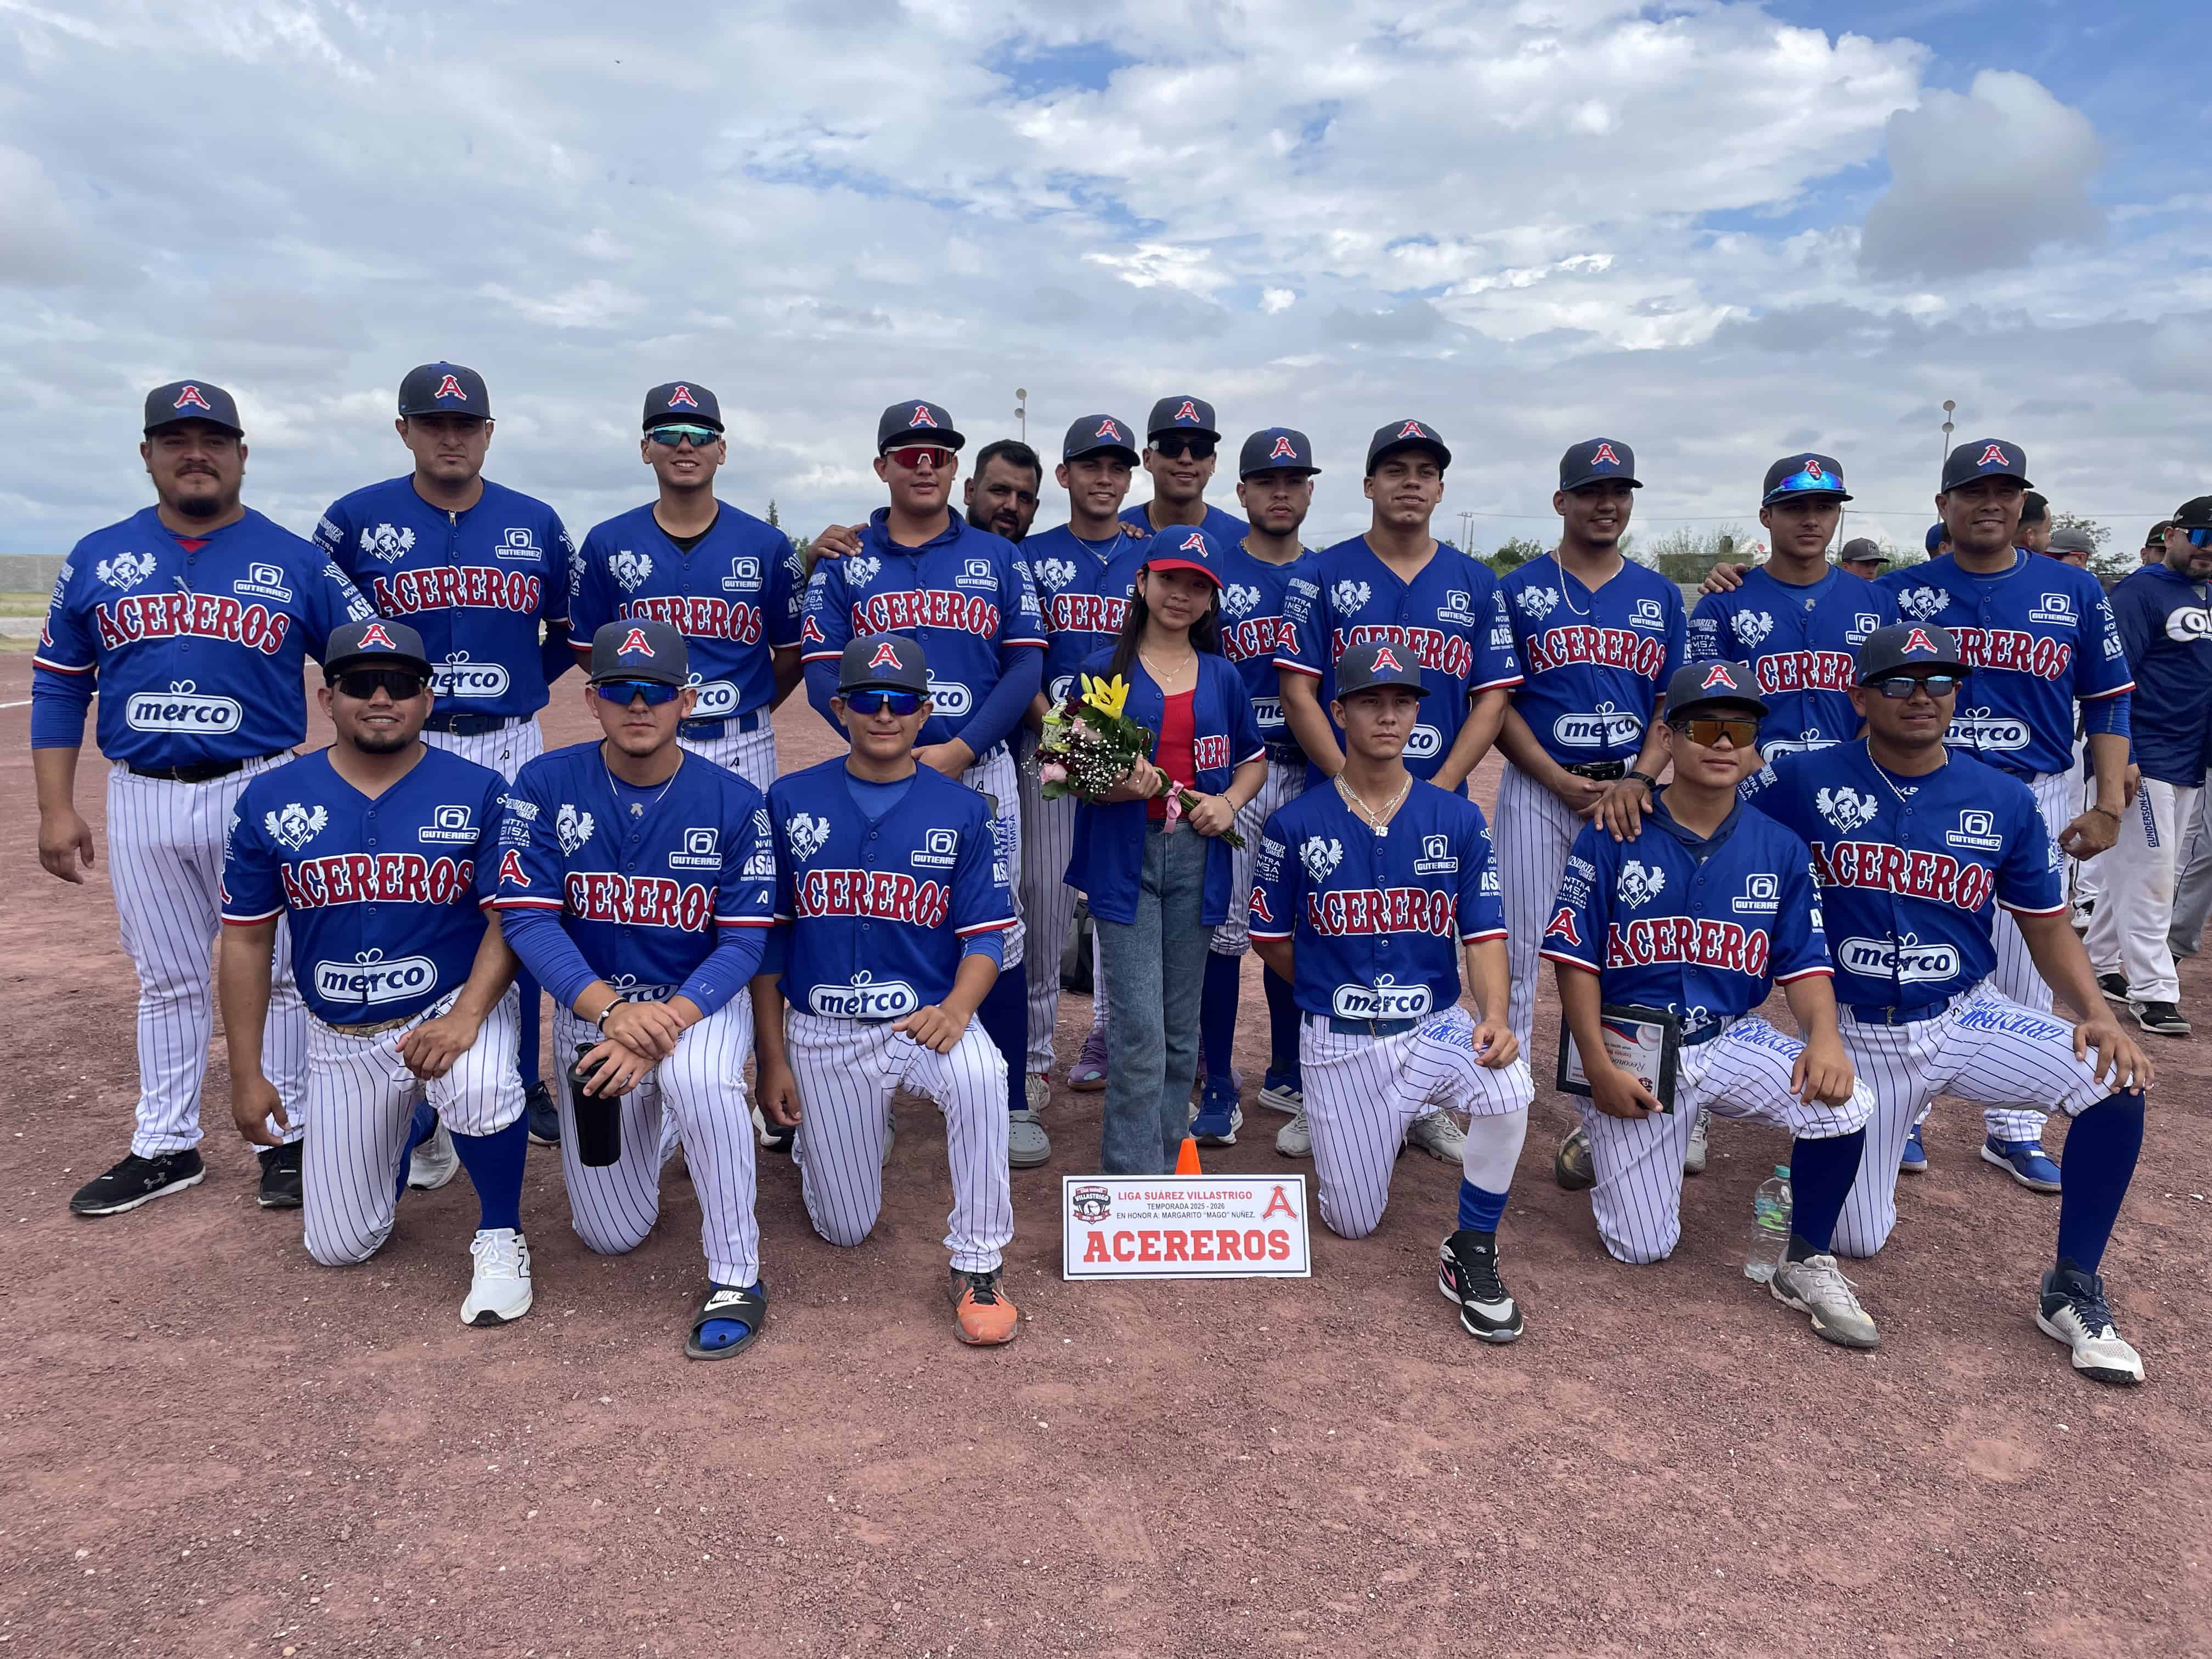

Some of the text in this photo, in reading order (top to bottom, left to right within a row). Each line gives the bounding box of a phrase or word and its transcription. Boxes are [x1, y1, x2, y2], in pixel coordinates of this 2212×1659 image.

[173, 385, 211, 410] A
[435, 374, 467, 400] A
[668, 385, 698, 408] A
[909, 405, 938, 428] A
[1175, 401, 1200, 423] A
[1096, 419, 1122, 441] A
[1397, 421, 1427, 439] A
[1269, 436, 1297, 459] A
[1591, 443, 1620, 466] A
[1977, 444, 2009, 466] A
[498, 548, 540, 559] GUTIERREZ
[1180, 533, 1208, 558] A
[237, 584, 290, 599] GUTIERREZ
[373, 565, 541, 618] ACEREROS
[958, 578, 997, 589] GUTIERREZ
[96, 591, 290, 655] ACEREROS
[851, 589, 1001, 640] ACEREROS
[2033, 613, 2076, 623] GUTIERREZ
[357, 623, 396, 650] A
[802, 615, 825, 644] A
[1276, 622, 1301, 655] A
[1900, 628, 1939, 655] A
[617, 628, 655, 657] A
[1526, 626, 1667, 682] ACEREROS
[868, 642, 902, 670] A
[1370, 647, 1403, 673] A
[1701, 665, 1738, 691] A
[134, 701, 230, 724] merco
[422, 830, 479, 840] GUTIERREZ
[1375, 825, 1389, 837] 15
[1949, 833, 2001, 847] GUTIERREZ
[499, 849, 531, 887] A
[914, 855, 956, 865] GUTIERRE
[281, 853, 474, 910] ACEREROS
[1812, 841, 1995, 912] ACEREROS
[792, 868, 951, 929] ACEREROS
[1249, 886, 1274, 922] A
[1735, 900, 1779, 910] GUTIERRE
[1545, 907, 1582, 946] A
[1851, 946, 1950, 971] merco
[322, 967, 425, 992] merco
[820, 991, 906, 1015] merco
[1344, 992, 1424, 1012] merco
[1074, 1193, 1109, 1203] VILLASTRIGO
[1118, 1189, 1253, 1200] LIGA SUÁREZ VILLASTRIGO
[1260, 1184, 1299, 1222] A
[1083, 1229, 1291, 1262] ACEREROS
[712, 1290, 744, 1302] NIKE
